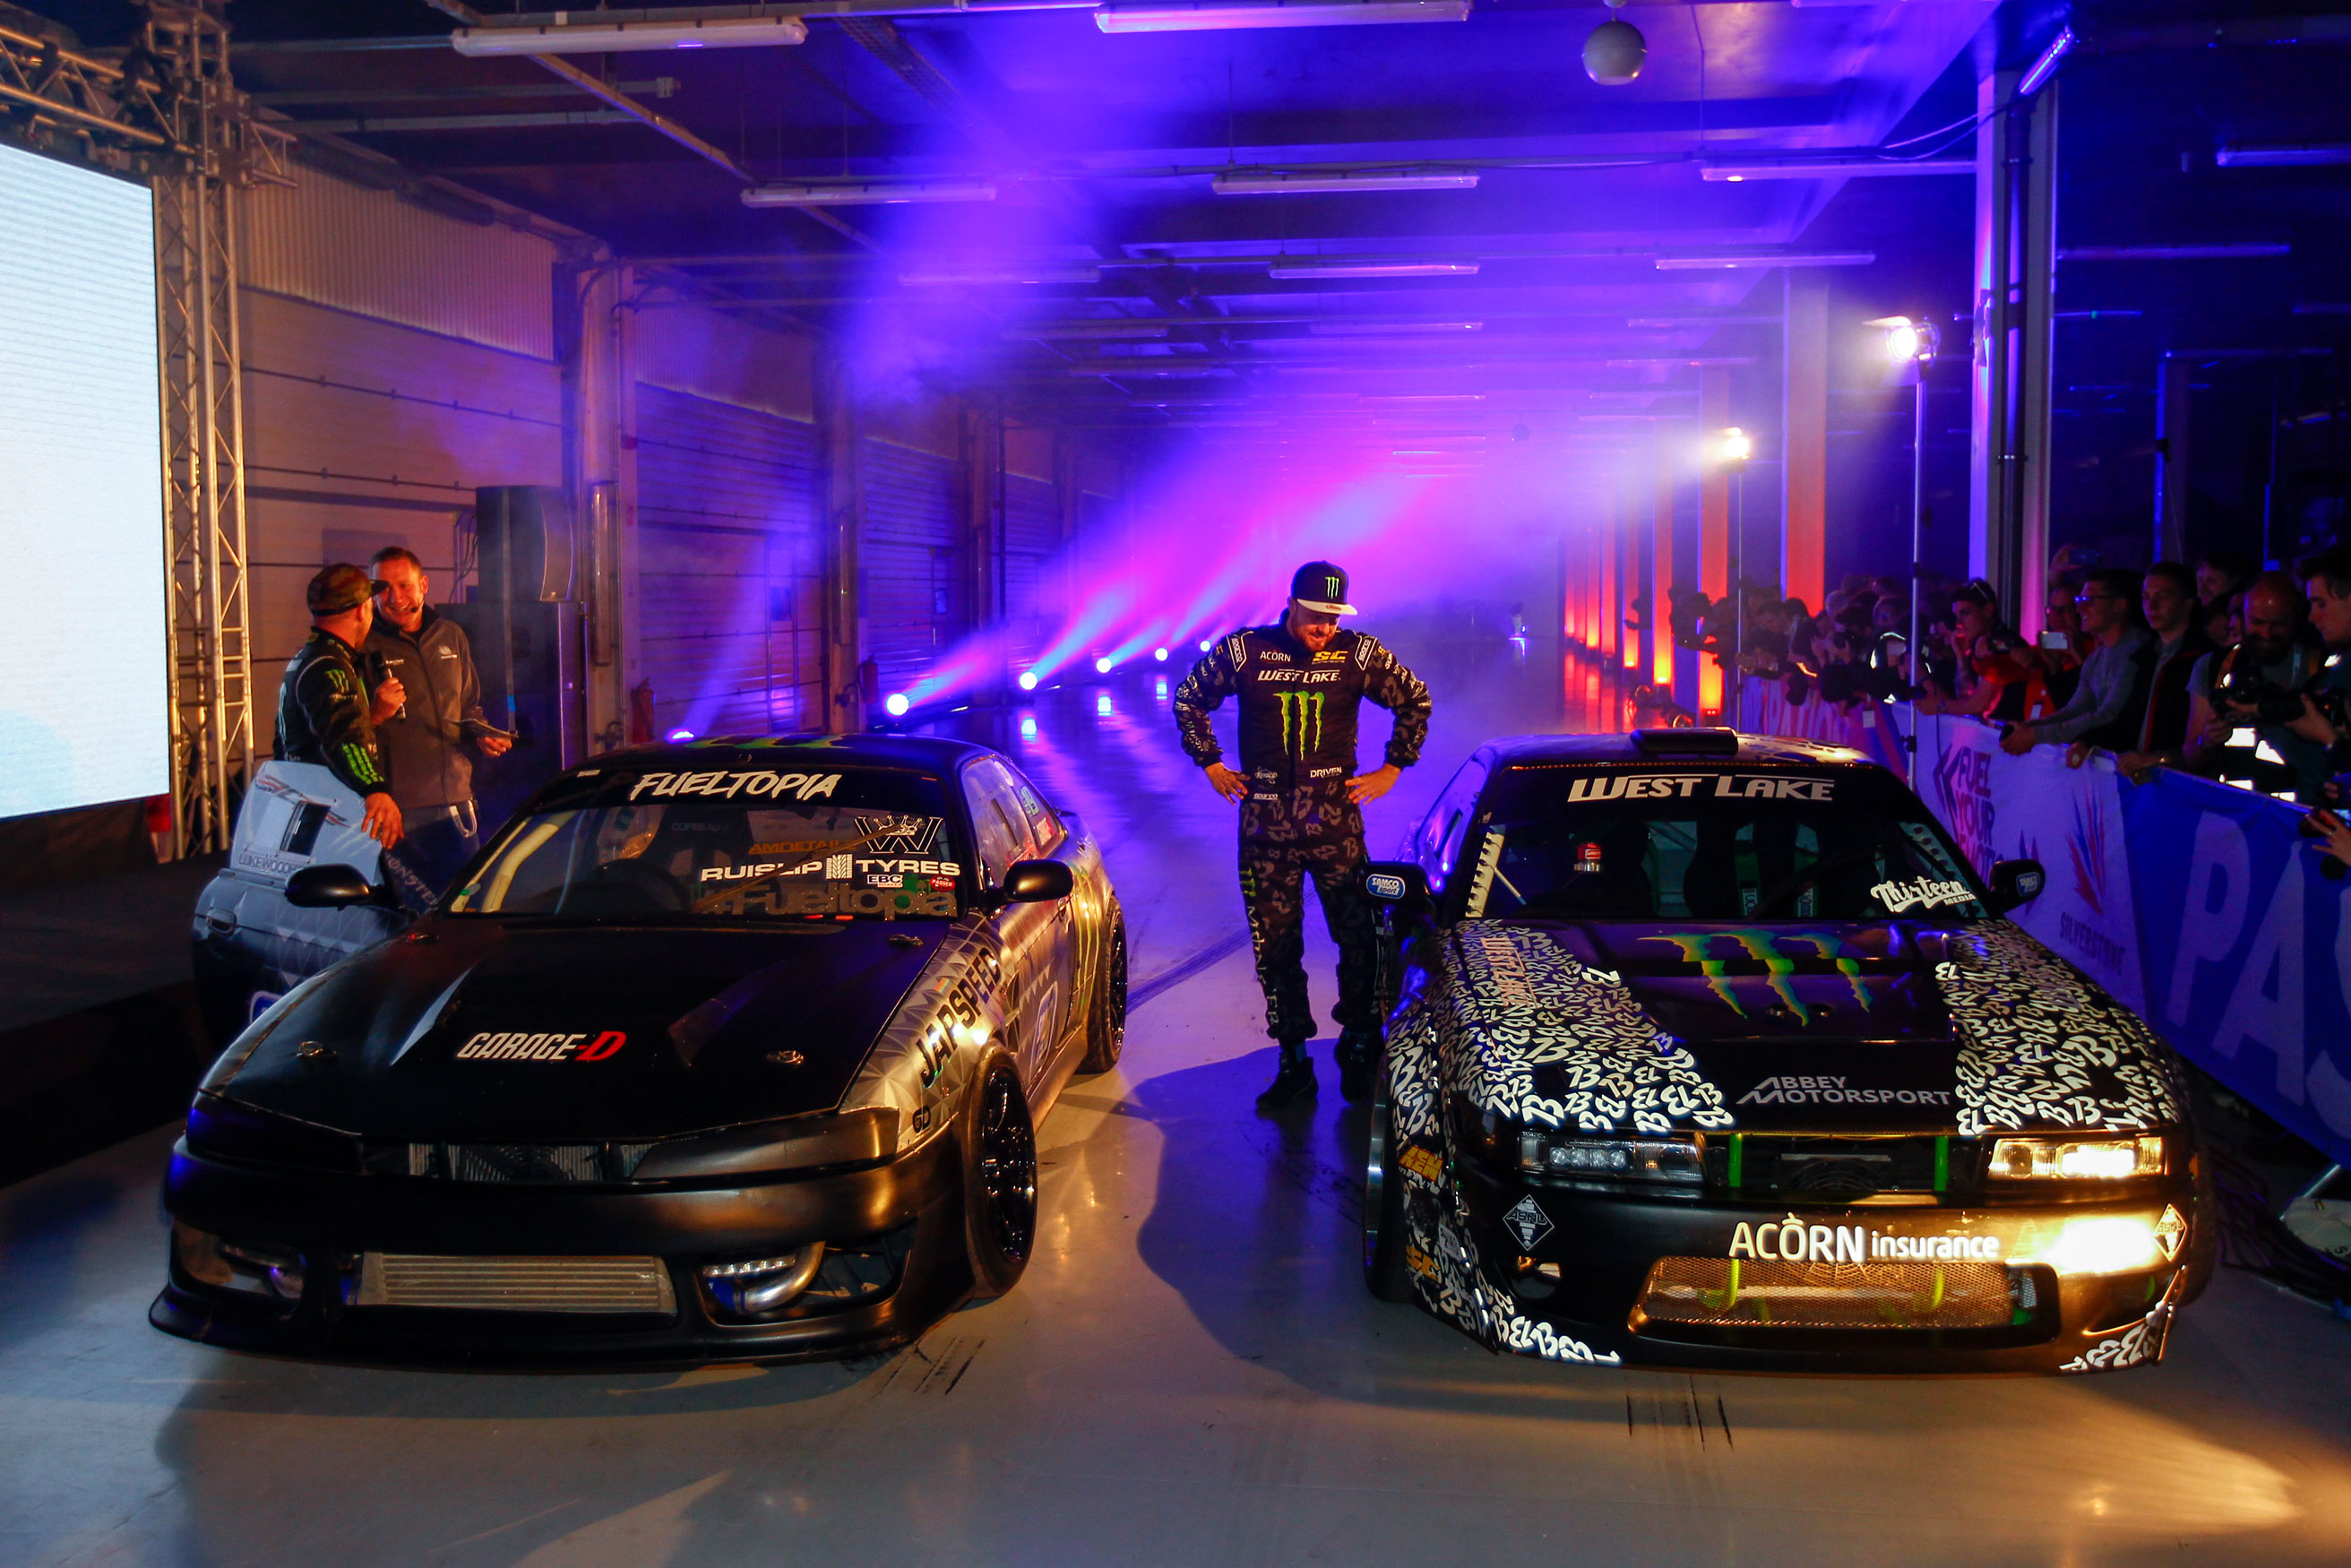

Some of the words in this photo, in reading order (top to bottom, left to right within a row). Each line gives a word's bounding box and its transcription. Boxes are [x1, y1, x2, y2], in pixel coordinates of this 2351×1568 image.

[1260, 650, 1291, 662] ACORN
[1257, 669, 1304, 682] WEST
[1302, 669, 1340, 684] LAKE
[1310, 766, 1342, 779] DRIVEN
[630, 771, 843, 800] FUELTOPIA
[1568, 774, 1705, 803] WEST
[1714, 774, 1835, 801] LAKE
[1955, 788, 1995, 847] YOUR
[856, 858, 961, 877] TYRES
[867, 874, 903, 883] EBC
[932, 878, 953, 887] PASSED
[1371, 877, 1399, 889] SAMCO
[1870, 874, 1971, 913] Thirteen
[1942, 892, 1978, 907] MEDIA
[2059, 911, 2126, 976] SILVERSTONE
[915, 946, 1003, 1090] JAPSPEED
[456, 1030, 627, 1061] GARAGE-D
[1754, 1076, 1846, 1090] ABBEY
[1735, 1089, 1951, 1105] MOTORSPORT
[1505, 1210, 1548, 1226] ASNU
[1729, 1215, 1863, 1262] ACORN
[1872, 1230, 2001, 1260] insurance
